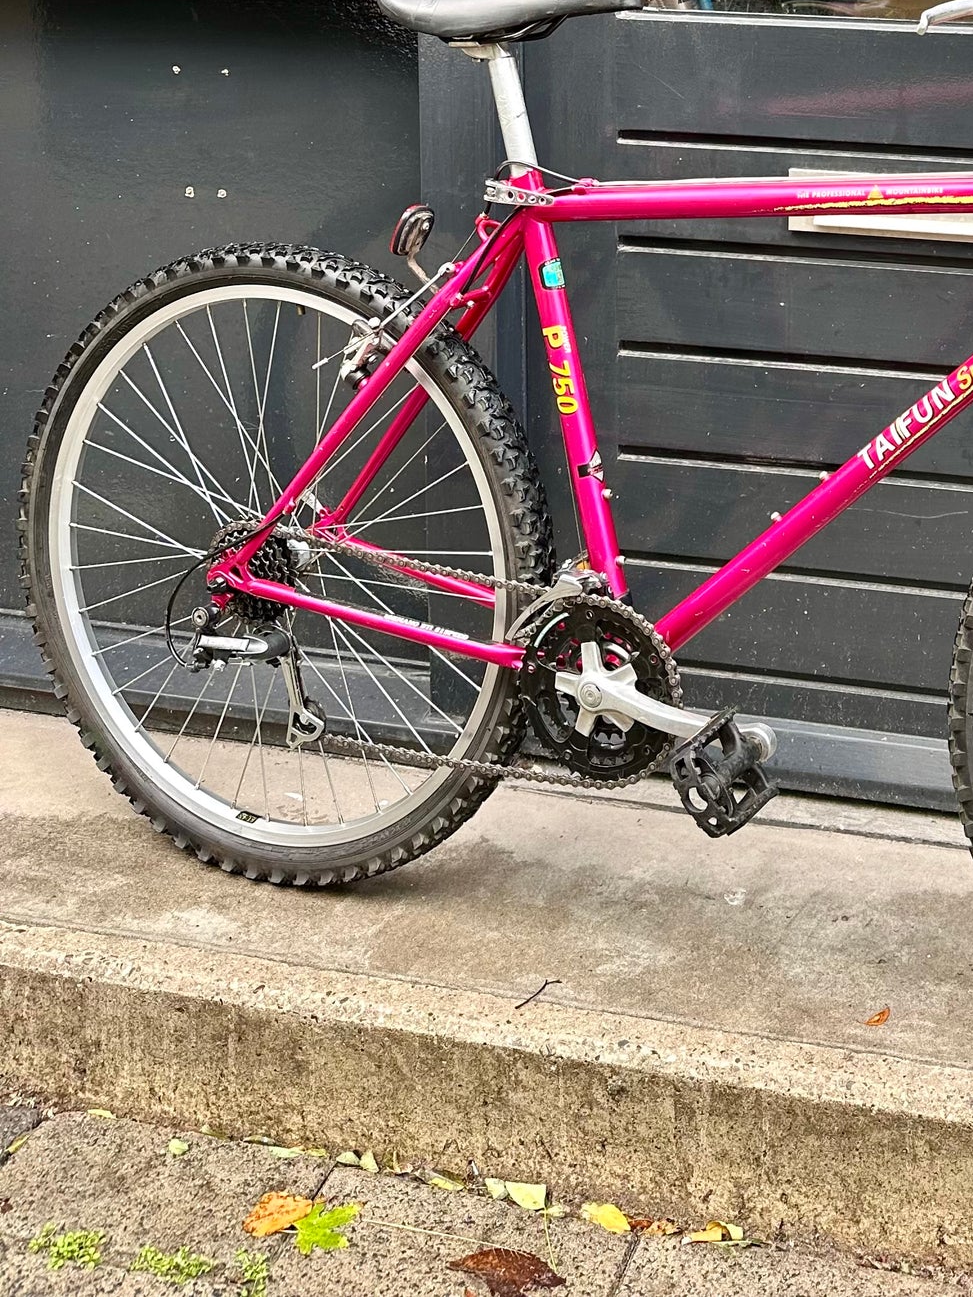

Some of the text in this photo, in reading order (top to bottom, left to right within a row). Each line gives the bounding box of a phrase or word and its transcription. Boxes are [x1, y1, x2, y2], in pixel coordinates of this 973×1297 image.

[812, 190, 866, 199] PROFESSIONAL
[886, 187, 944, 196] MOUNTAINBIKE
[542, 324, 579, 416] P 750
[857, 377, 956, 470] TAIFUN
